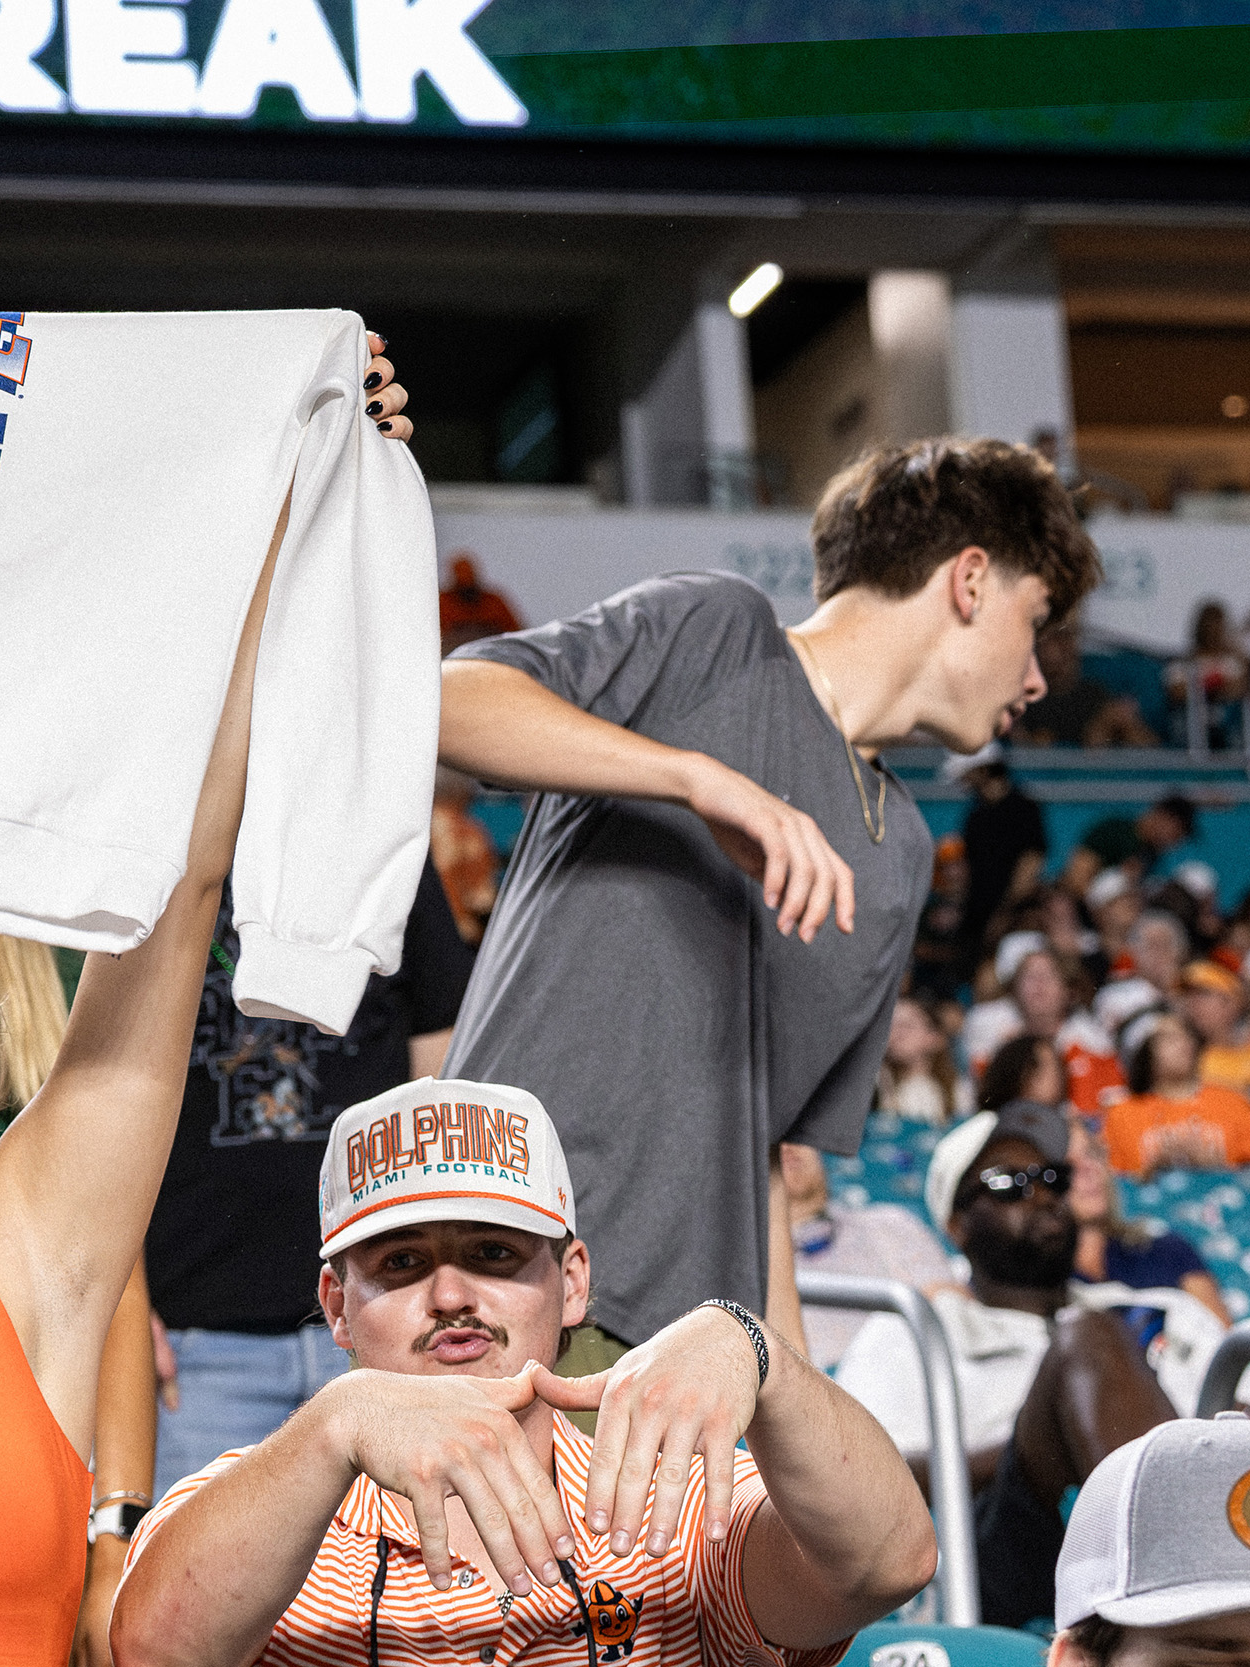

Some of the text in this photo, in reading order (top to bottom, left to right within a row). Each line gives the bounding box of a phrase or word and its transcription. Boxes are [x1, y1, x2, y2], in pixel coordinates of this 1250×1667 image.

[347, 1102, 530, 1194] DOLPHINS
[352, 1162, 532, 1205] MIAMI FOOTBALL
